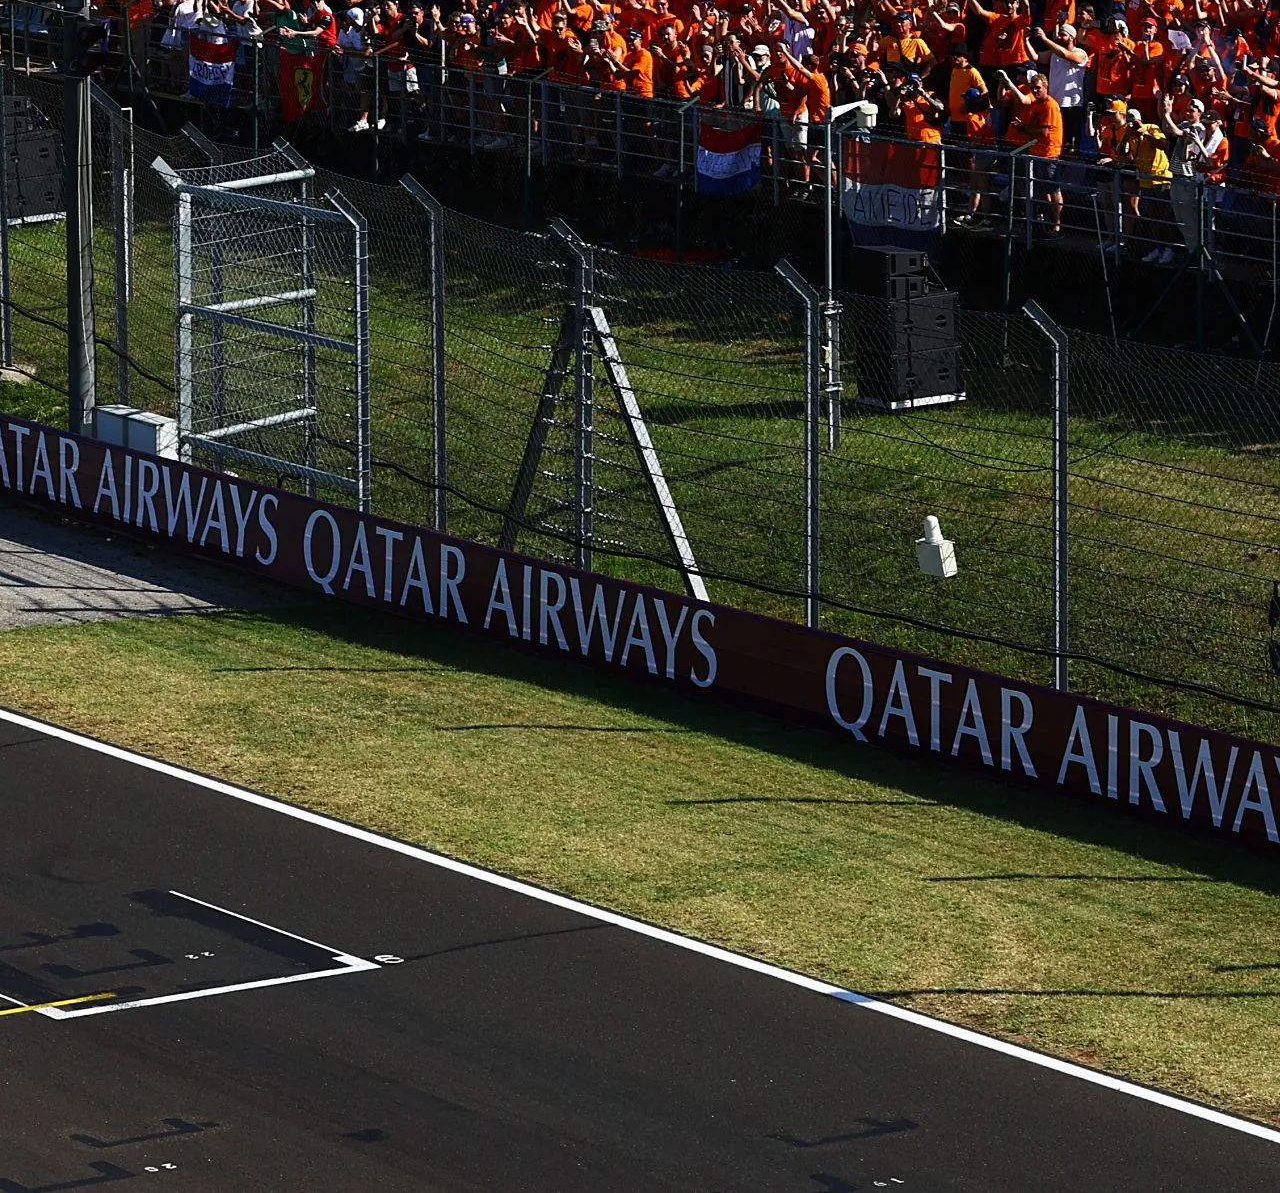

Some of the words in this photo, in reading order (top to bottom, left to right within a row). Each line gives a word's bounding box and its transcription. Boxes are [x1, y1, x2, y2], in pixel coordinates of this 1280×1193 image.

[93, 448, 280, 566] AIRWAYS
[303, 509, 469, 625] QATAR
[484, 558, 718, 689] AIRWAYS
[825, 645, 1039, 780] QATAR
